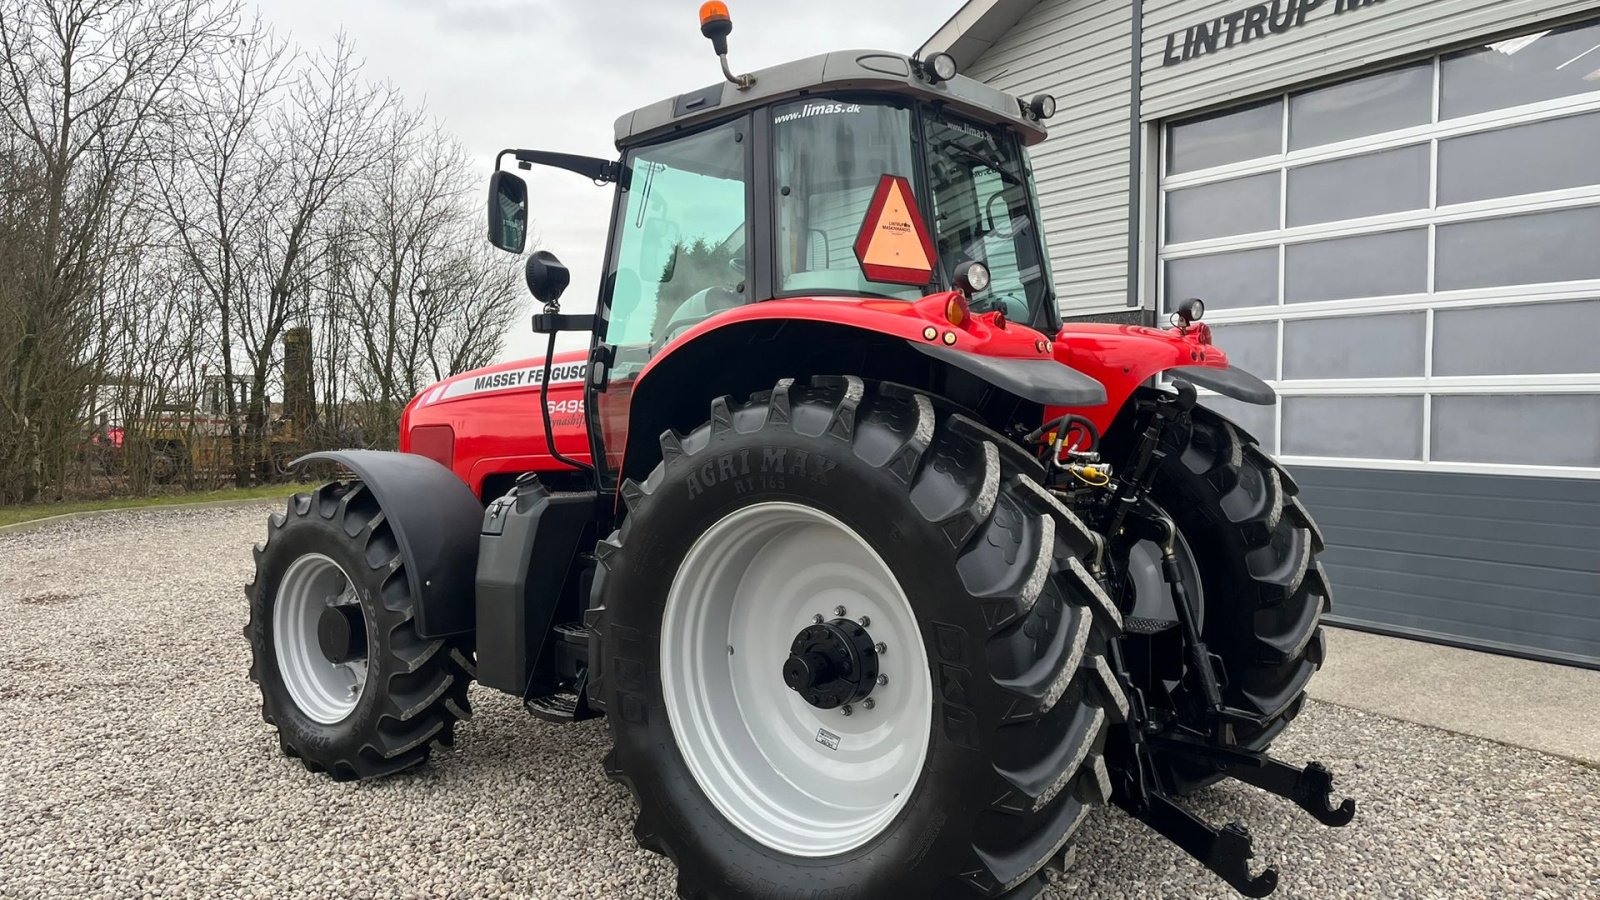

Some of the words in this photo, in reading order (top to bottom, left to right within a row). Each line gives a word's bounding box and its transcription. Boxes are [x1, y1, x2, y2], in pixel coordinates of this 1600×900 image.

[1163, 0, 1323, 66] LINTRUP
[774, 103, 861, 124] www.limas.dk
[474, 371, 525, 391] MASSEY
[685, 448, 751, 501] AGRI
[760, 445, 838, 487] MAX
